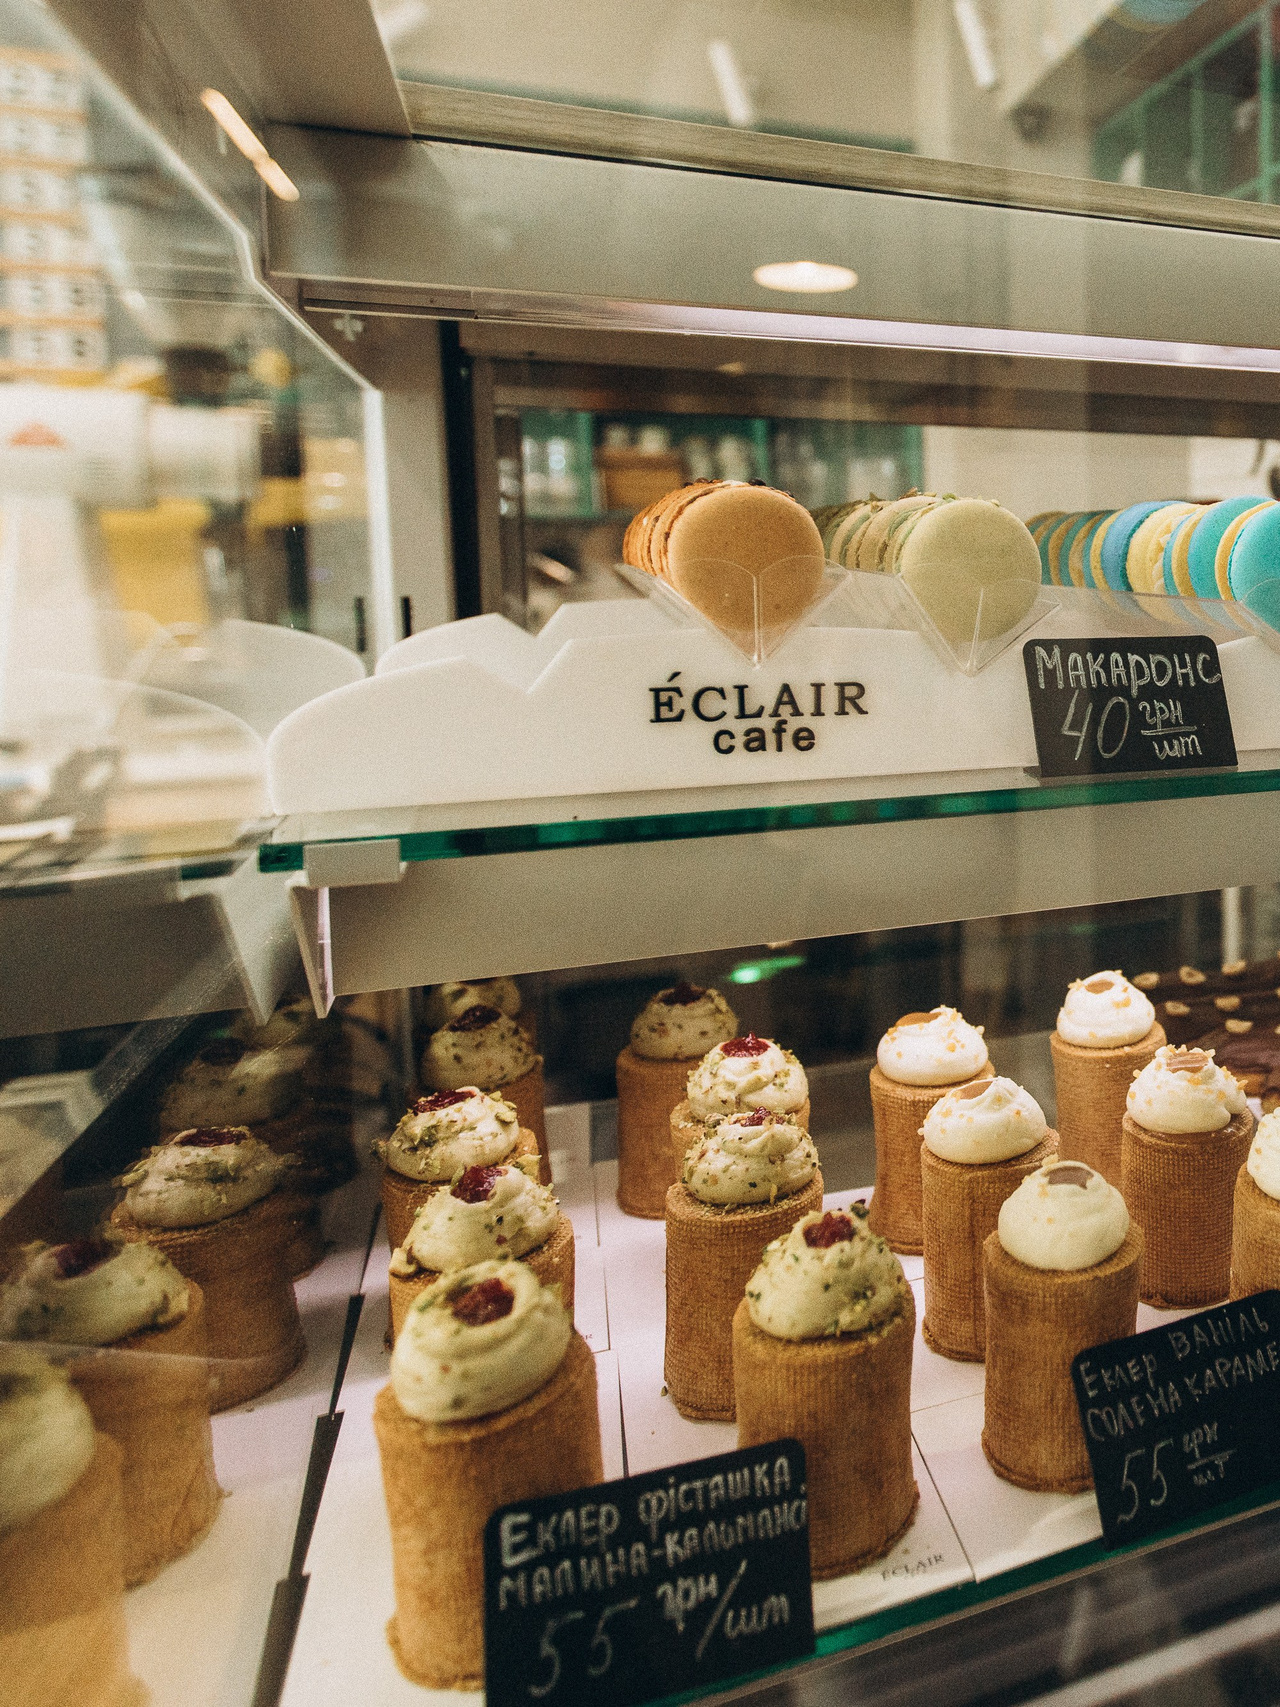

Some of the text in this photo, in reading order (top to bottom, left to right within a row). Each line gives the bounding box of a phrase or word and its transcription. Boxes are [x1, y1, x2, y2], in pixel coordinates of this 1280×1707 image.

[649, 671, 869, 723] ÉCLAIR
[1061, 690, 1131, 761] 40
[712, 720, 816, 755] cafe
[1117, 1438, 1173, 1524] 55
[529, 1598, 639, 1698] 55
